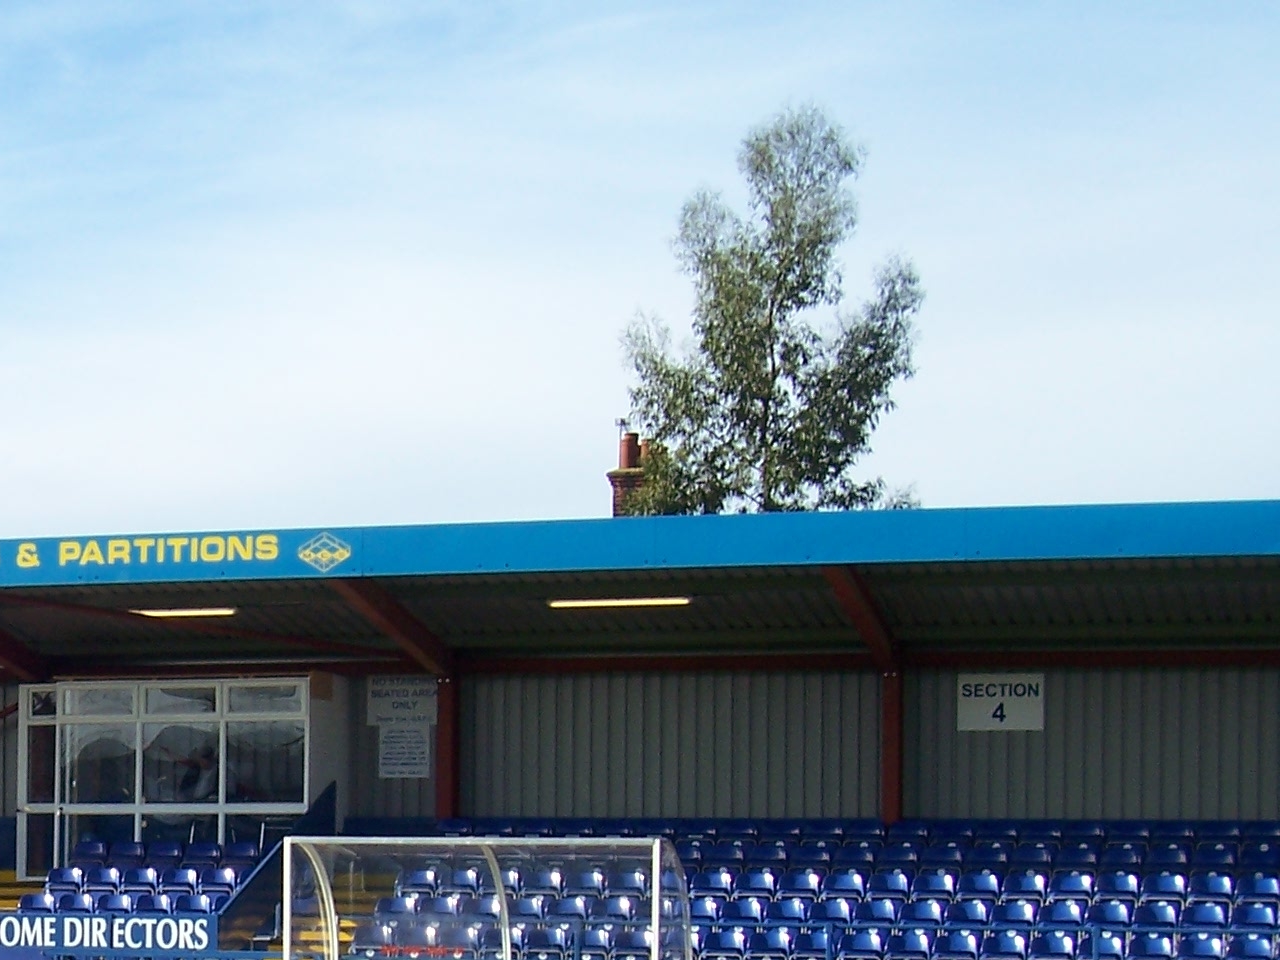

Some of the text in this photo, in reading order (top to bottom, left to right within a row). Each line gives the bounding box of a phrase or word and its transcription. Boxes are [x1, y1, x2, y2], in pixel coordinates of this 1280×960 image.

[16, 543, 40, 568] &
[59, 534, 280, 566] PARTITIONS
[961, 682, 1040, 698] SECTION
[992, 702, 1007, 723] 4
[63, 917, 209, 950] DIRECTORS
